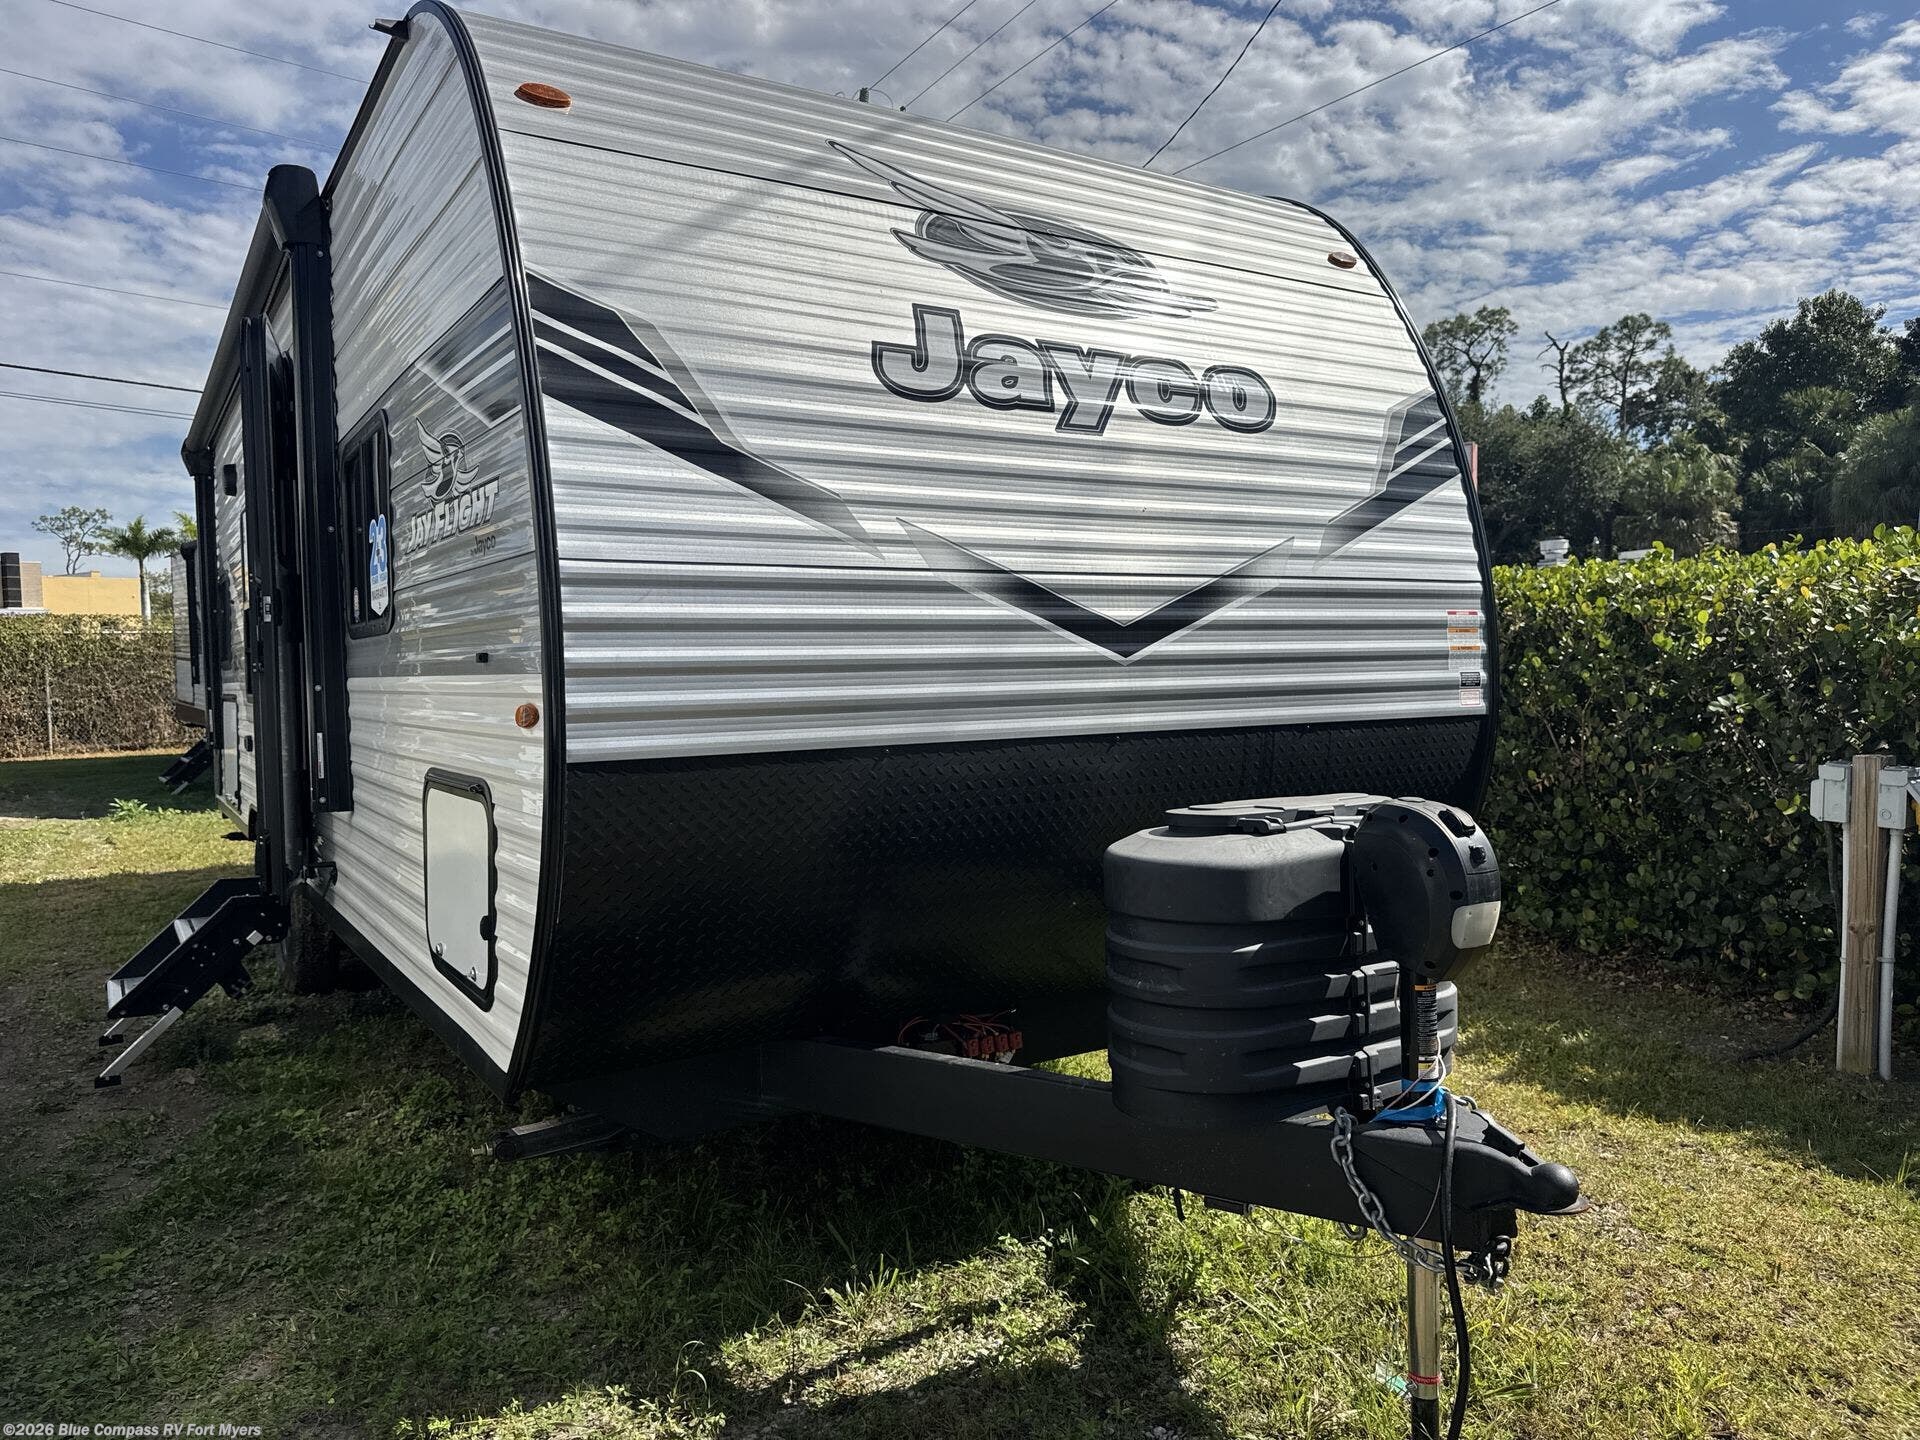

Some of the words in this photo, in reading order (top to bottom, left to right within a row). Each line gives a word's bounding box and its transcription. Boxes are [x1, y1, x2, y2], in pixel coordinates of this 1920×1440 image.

[871, 302, 1277, 436] Jayco
[405, 508, 433, 555] JAY
[432, 478, 499, 545] FLIGHT
